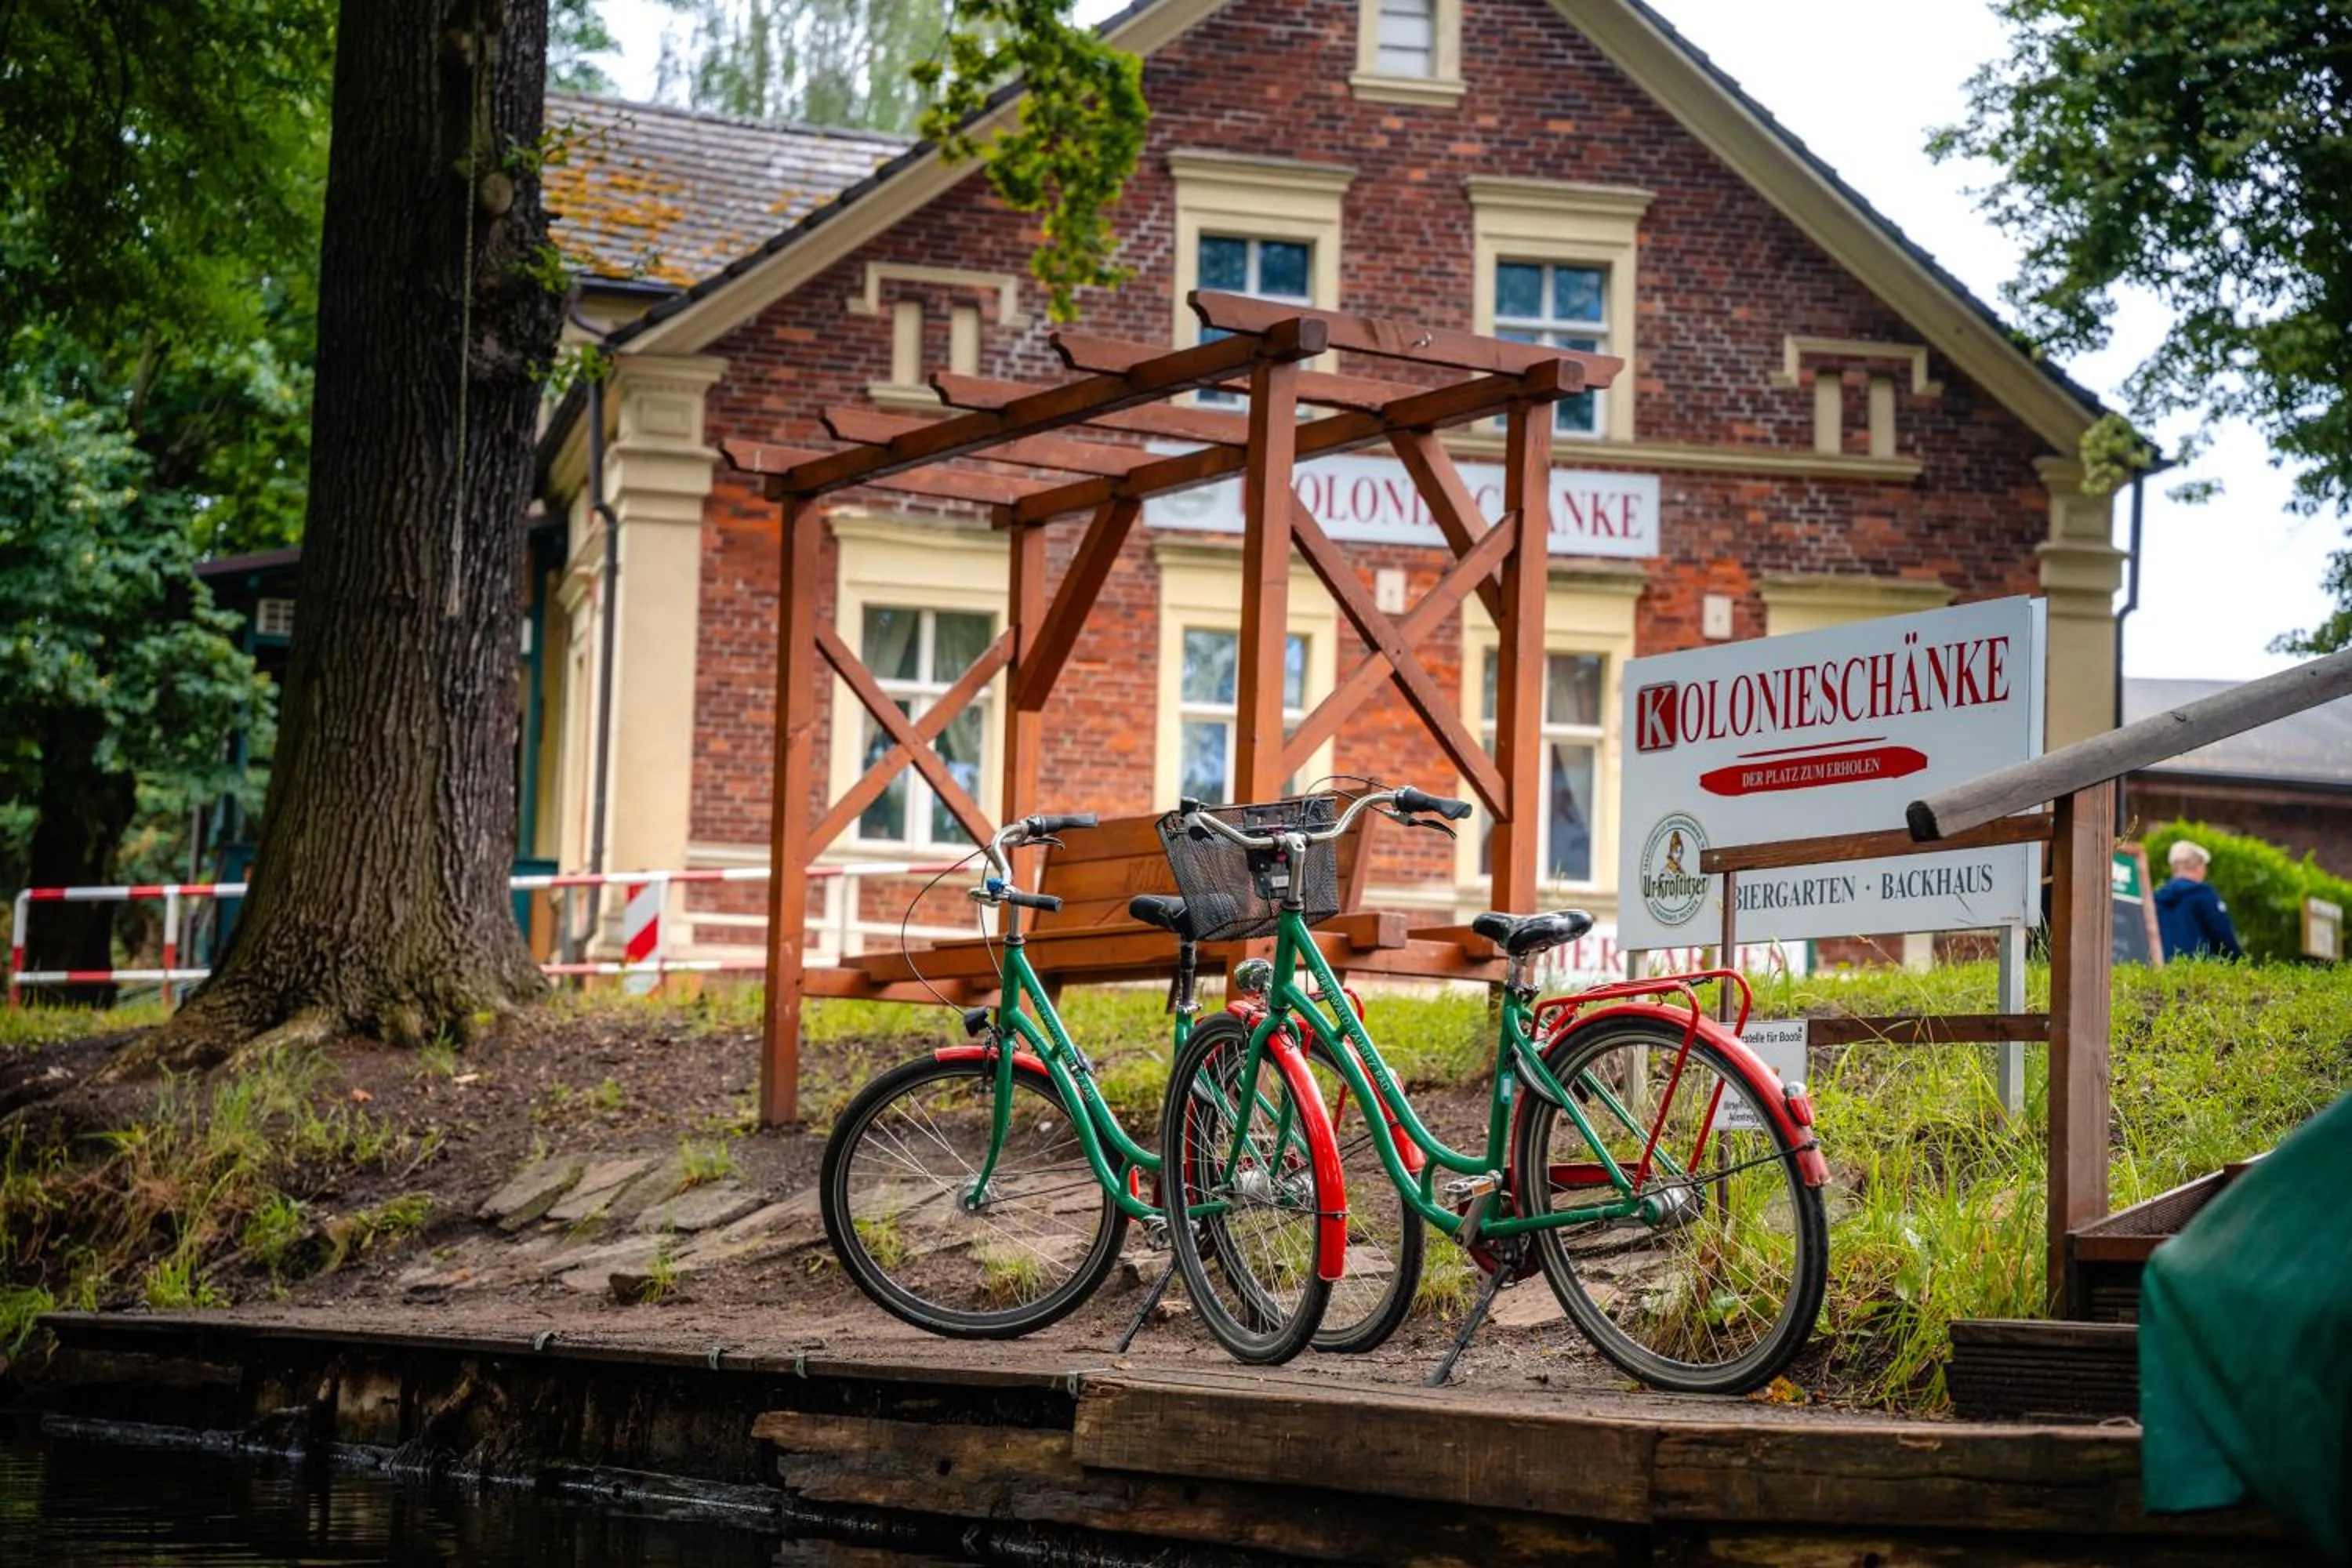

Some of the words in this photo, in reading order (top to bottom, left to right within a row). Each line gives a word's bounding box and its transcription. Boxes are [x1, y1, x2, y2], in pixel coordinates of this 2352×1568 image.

[1639, 632, 2009, 752] KOLONIESCHÄNKE
[1742, 771, 1763, 788] DER
[1766, 766, 1799, 785] PLATZ
[1800, 764, 1825, 781] ZUM
[1826, 757, 1881, 778] ERHOLEN
[1882, 864, 1994, 900] BACKHAUS
[1374, 1069, 1391, 1093] RAD
